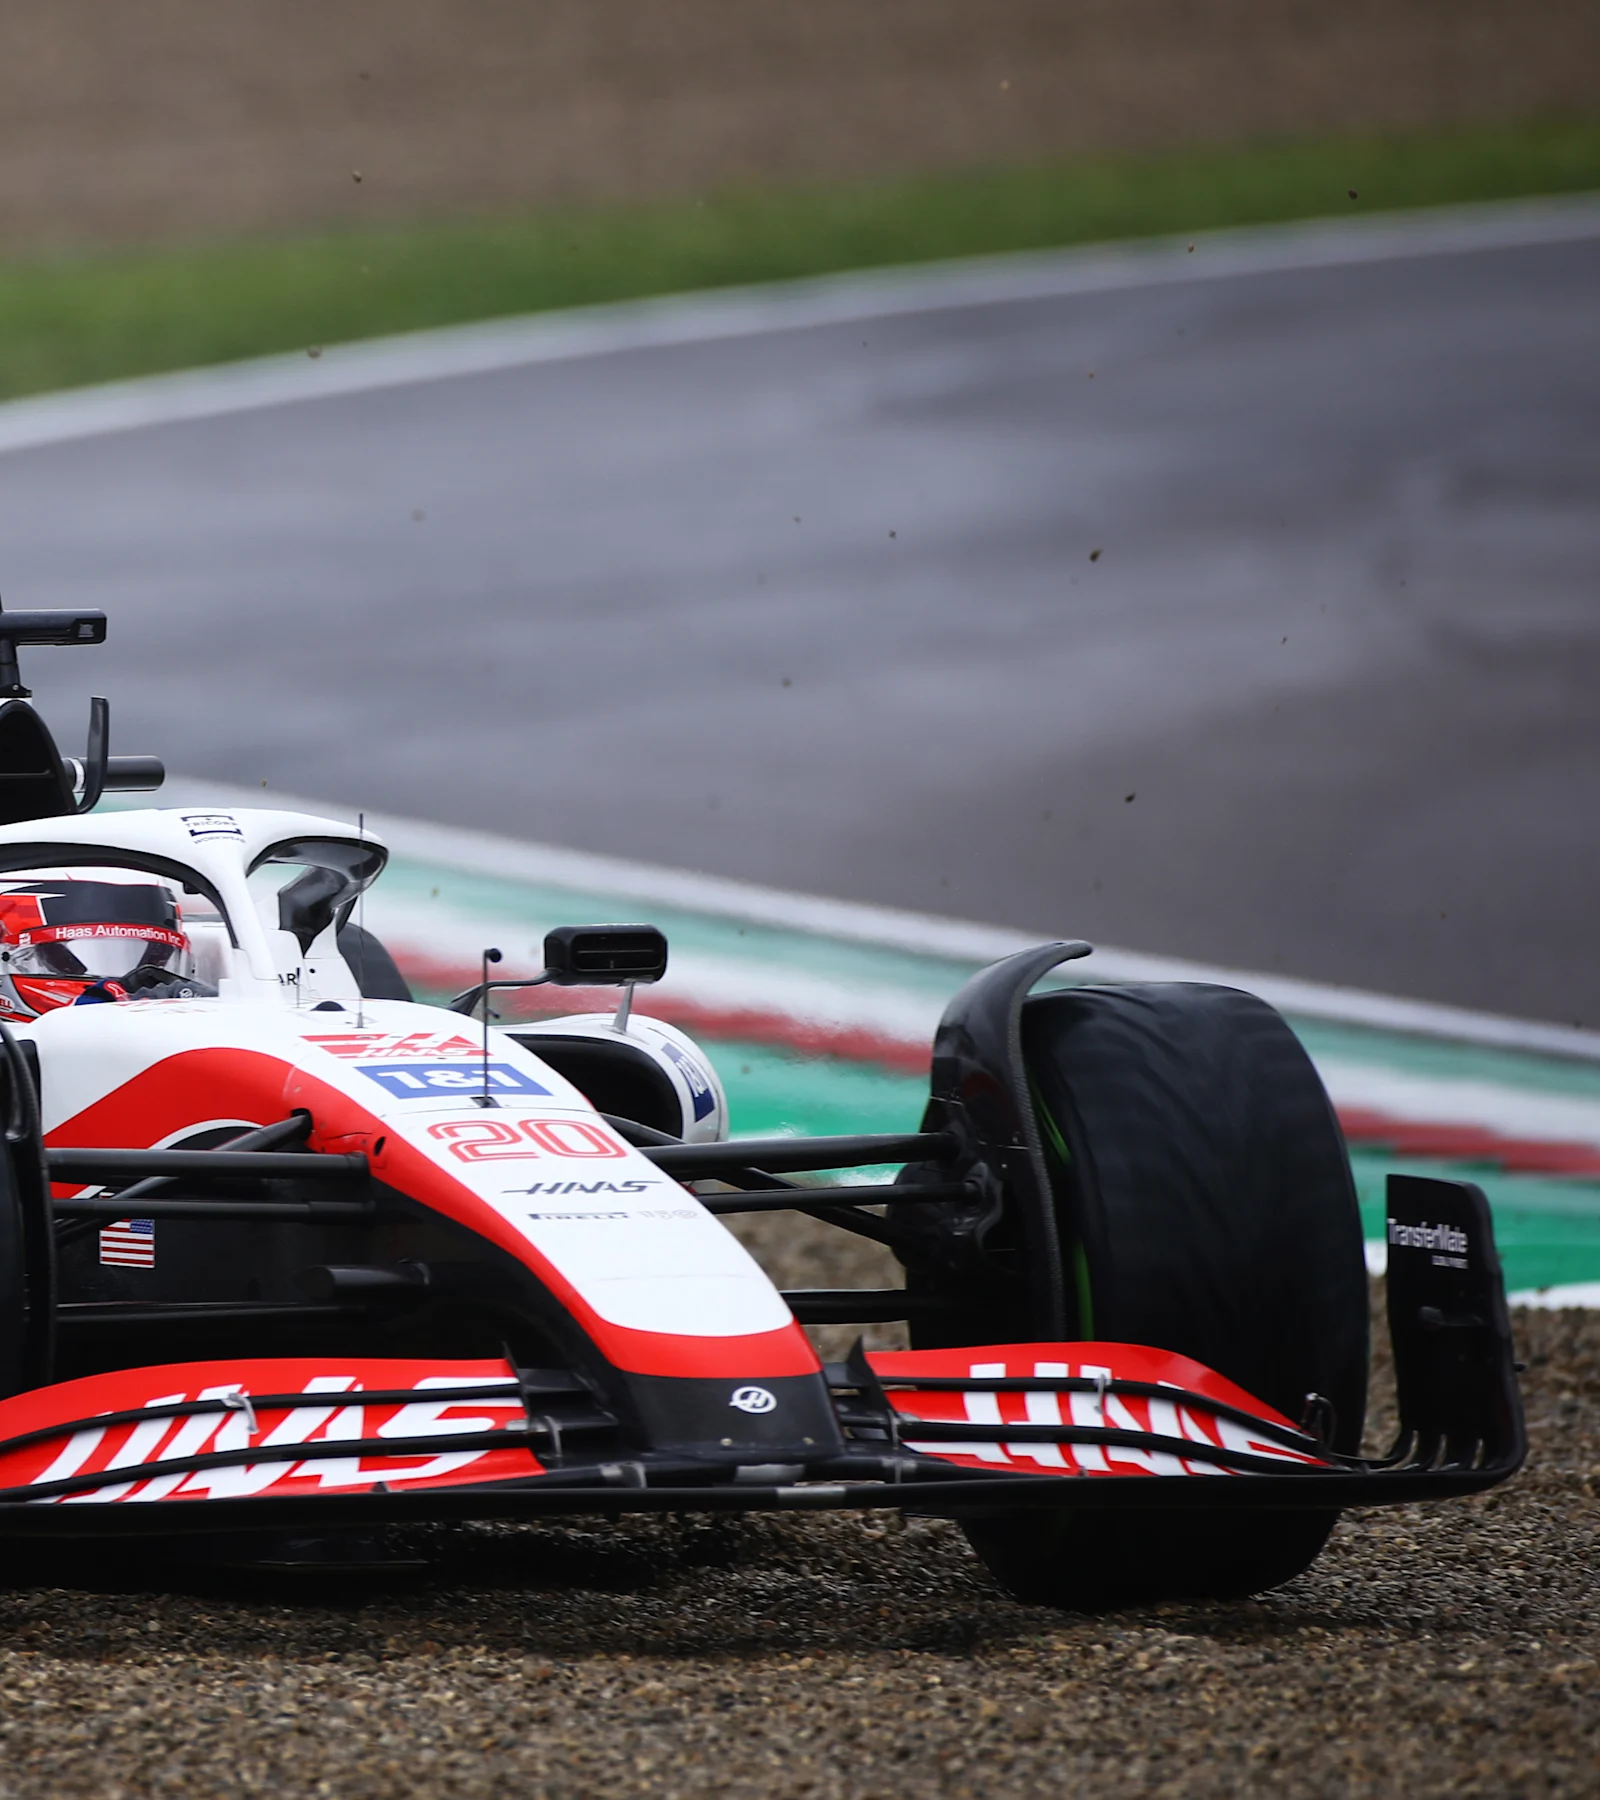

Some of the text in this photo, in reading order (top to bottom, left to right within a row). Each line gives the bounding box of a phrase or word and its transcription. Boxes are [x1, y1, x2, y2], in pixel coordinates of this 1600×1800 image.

[55, 926, 92, 939] Haas
[94, 924, 167, 942] Automation
[377, 1070, 522, 1089] 1&1
[427, 1119, 628, 1163] 20
[500, 1180, 663, 1195] HAAS
[25, 1376, 523, 1503] HAAS
